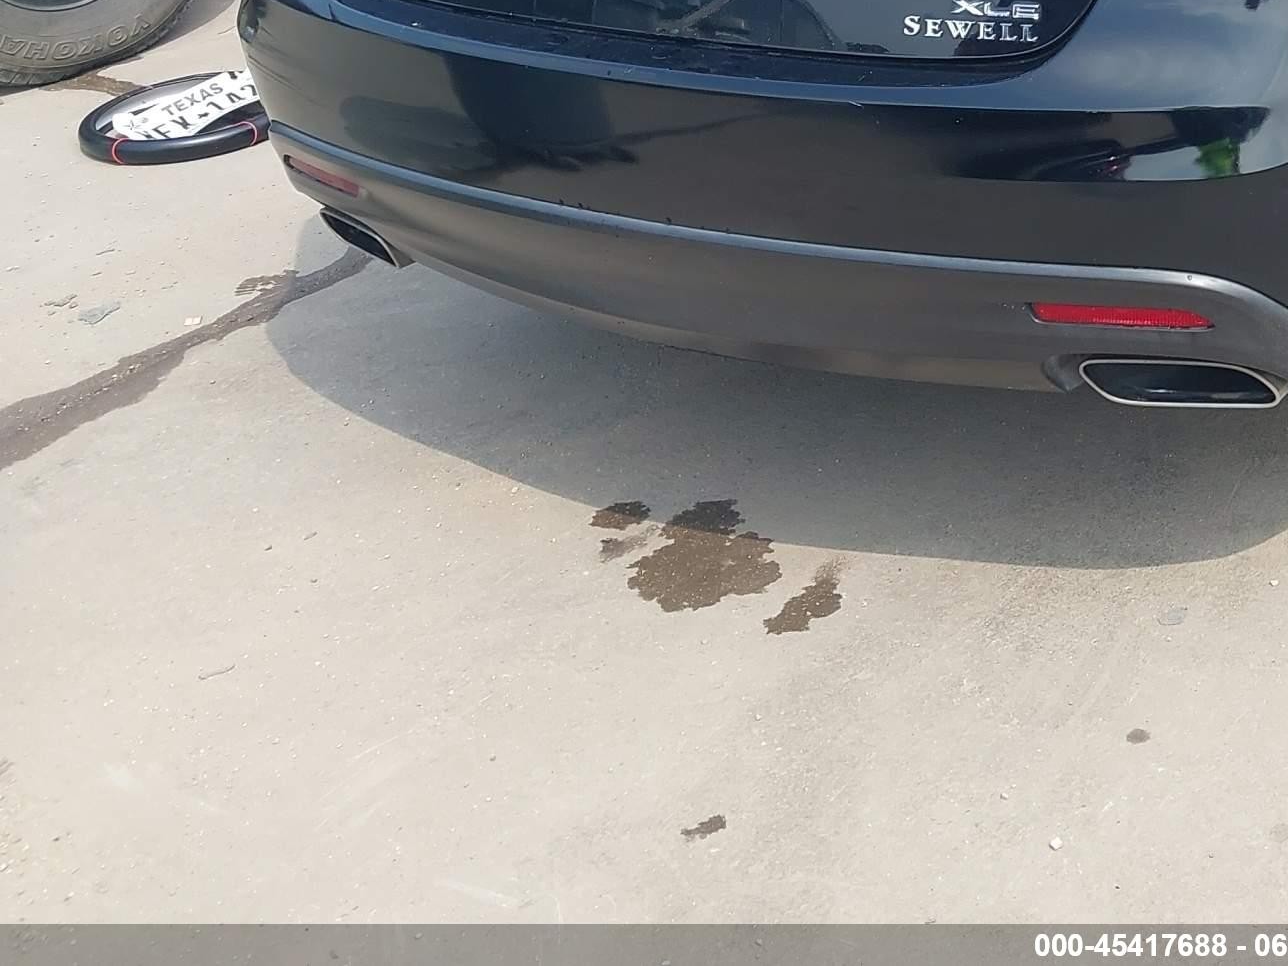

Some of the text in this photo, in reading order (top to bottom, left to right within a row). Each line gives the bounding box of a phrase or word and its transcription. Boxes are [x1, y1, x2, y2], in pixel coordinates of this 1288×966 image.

[951, 0, 1041, 20] XLE
[0, 13, 151, 61] YOKOHA
[903, 15, 1040, 43] SEWELL
[161, 82, 224, 117] TEXAS
